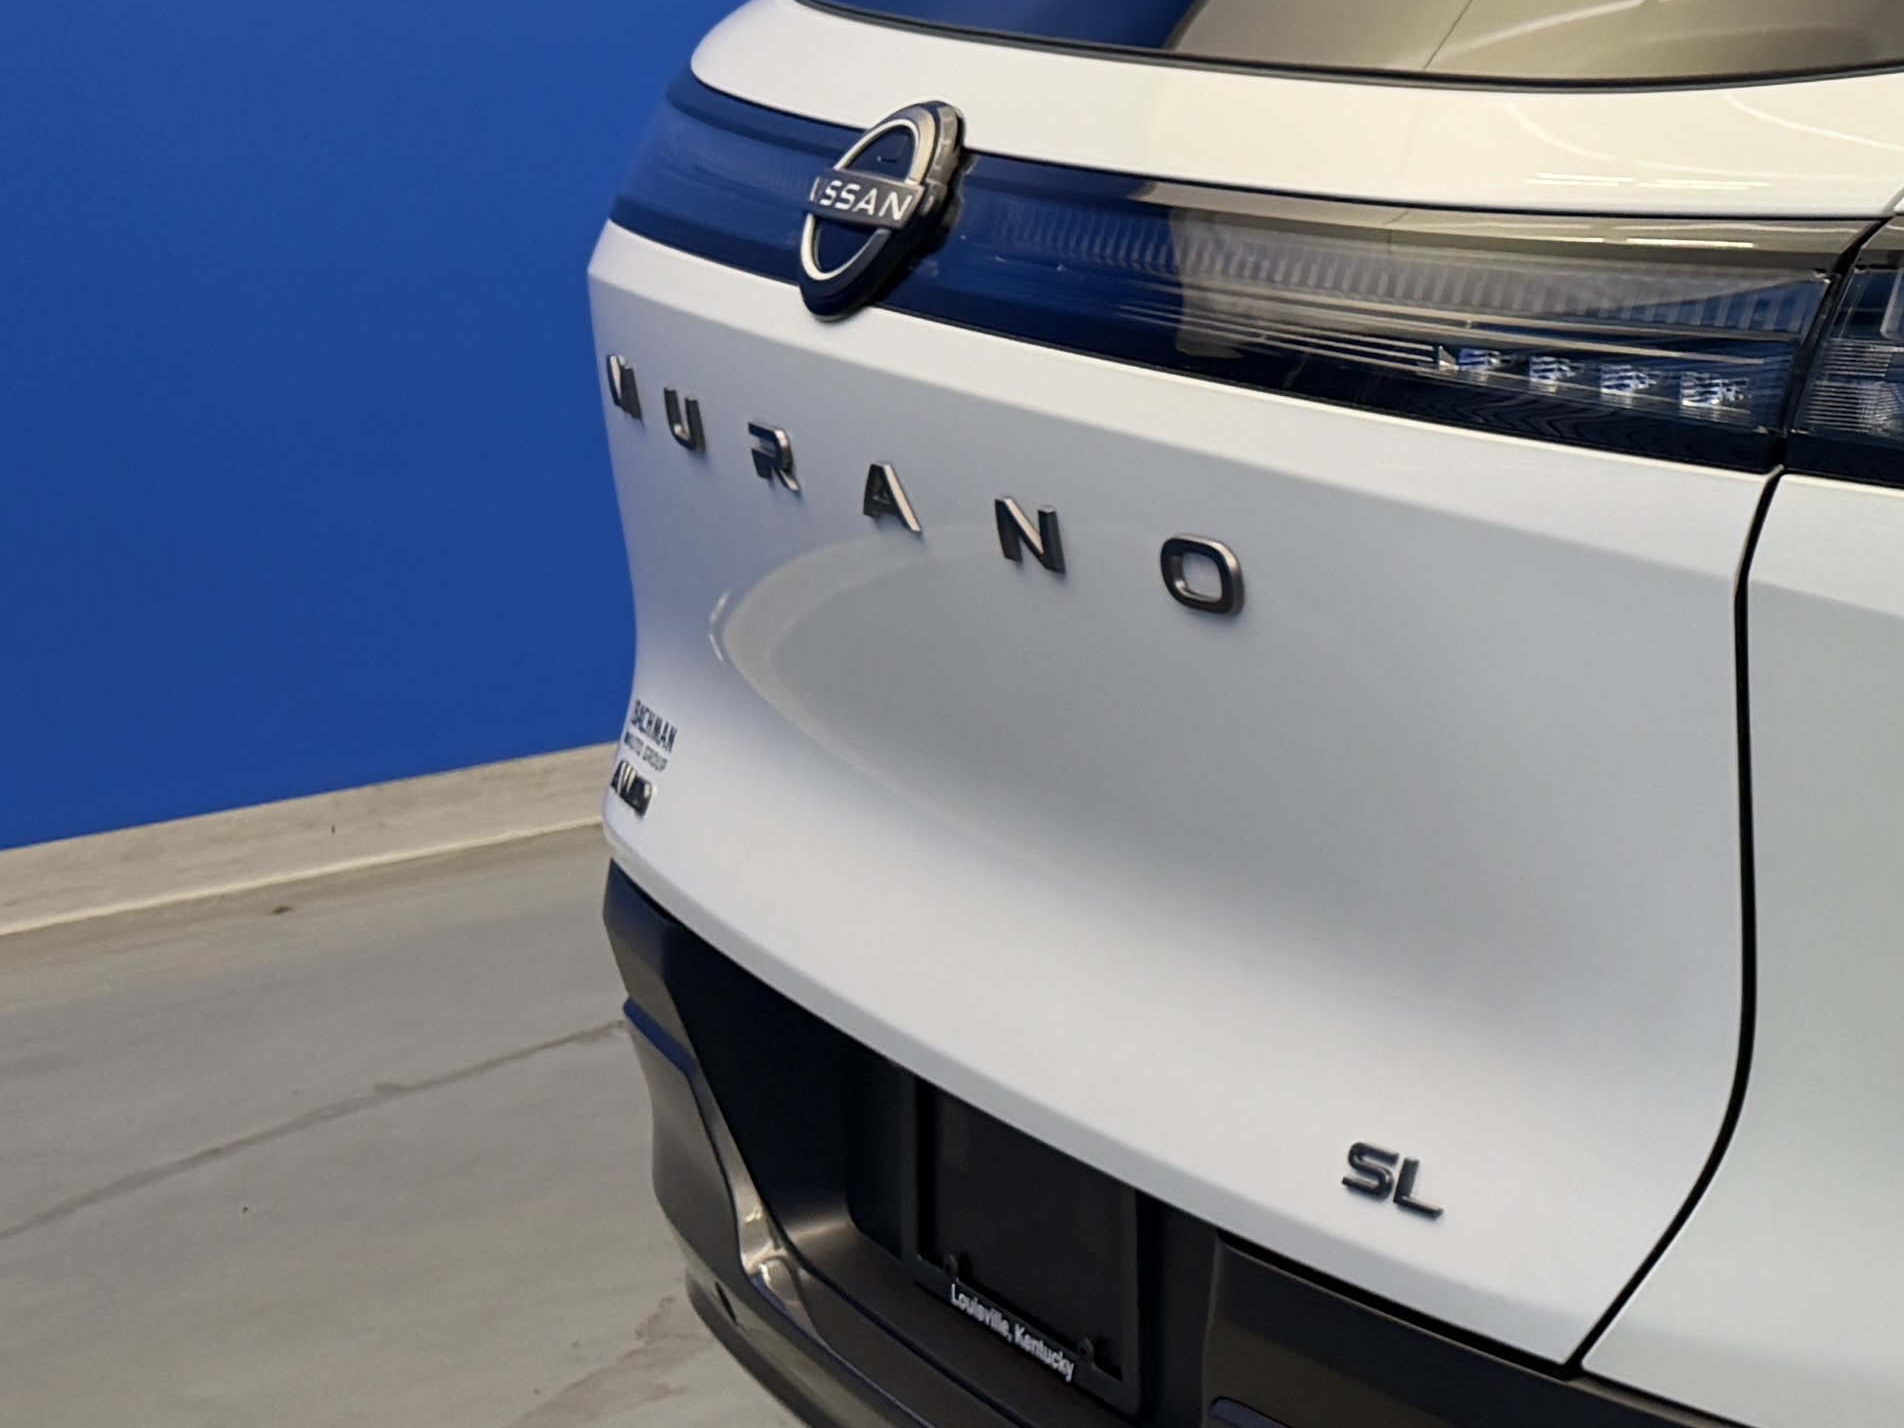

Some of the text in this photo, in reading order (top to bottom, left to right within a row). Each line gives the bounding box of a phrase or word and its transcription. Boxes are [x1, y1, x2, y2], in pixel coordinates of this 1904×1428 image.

[605, 354, 1246, 617] MURANO
[1341, 1140, 1444, 1219] SL
[1014, 1323, 1075, 1383] Kentucky
